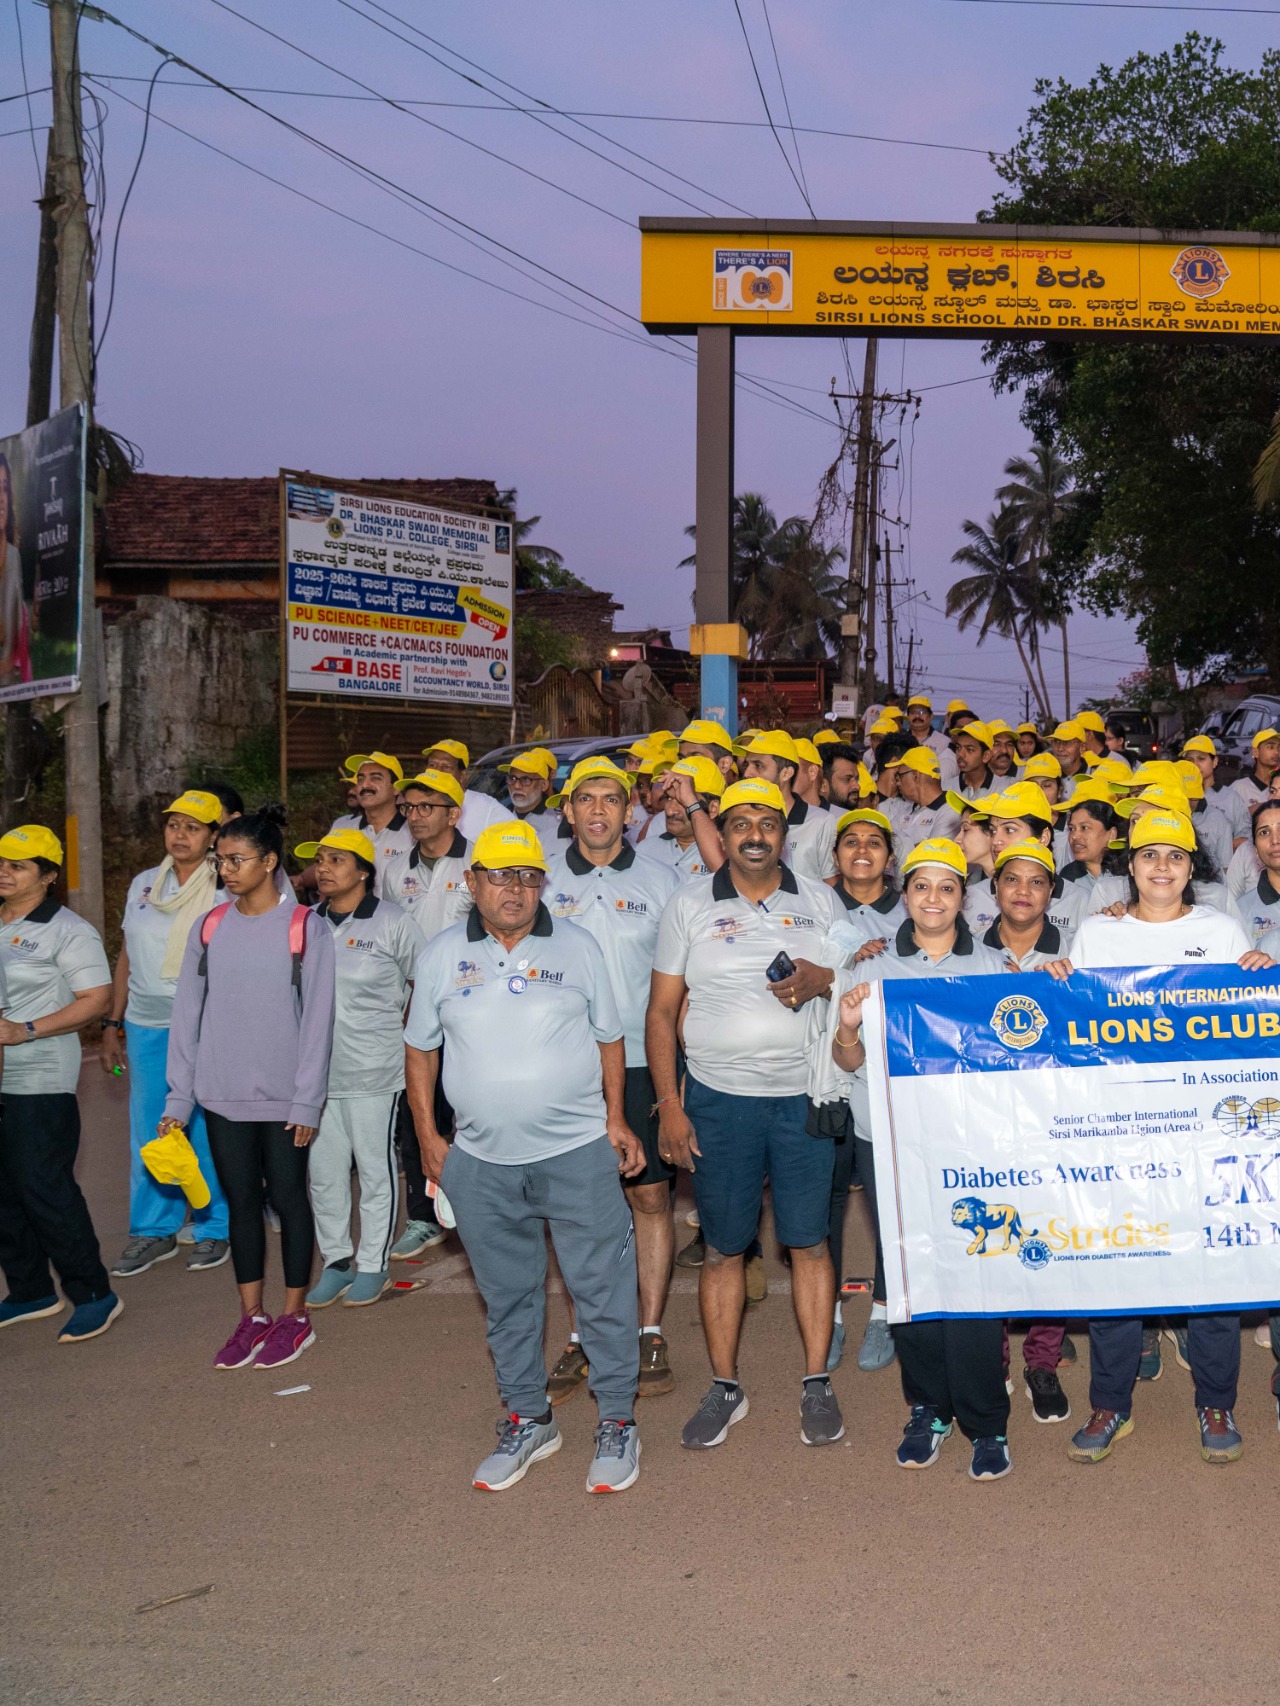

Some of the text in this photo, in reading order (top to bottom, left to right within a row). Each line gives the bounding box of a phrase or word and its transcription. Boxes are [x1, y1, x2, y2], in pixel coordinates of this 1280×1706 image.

[718, 257, 788, 266] THERE'S A LION
[938, 246, 995, 262] ನಗರಕ್ಕೆ
[1000, 247, 1073, 263] ಸುಸ್ವಾಗತ
[1184, 249, 1217, 264] LIONS
[1035, 265, 1106, 289] ಶಿರಸಿ
[816, 291, 859, 306] ಶಿರಸಿ
[933, 294, 987, 313] ಸ್ಕೂಲ್
[995, 295, 1042, 312] ಮತ್ತು
[1086, 297, 1139, 316] ಭಾಸ್ಕರ
[815, 311, 864, 323] SIRSI
[869, 312, 926, 324] LIONS
[931, 313, 1007, 326] SCHOOL
[1013, 314, 1052, 326] AND
[1057, 315, 1088, 327] DR.
[1093, 316, 1180, 330] BHASKAR
[1184, 318, 1240, 331] SWADI
[339, 496, 490, 532] SIRSI LIONS EDUCATION SOCIETY (R)
[339, 509, 491, 544] DR. BHASKAR SWADI MEMORIAL
[353, 522, 478, 553] LIONS P.U. COLLEGE, SIRSI
[323, 538, 388, 559] ಉತ್ತರಕನ್ನಡ
[295, 606, 314, 620] PU
[463, 595, 505, 620] ADMISSION
[477, 616, 501, 634] OPEN
[293, 626, 309, 641] PU
[312, 628, 378, 648] COMMERCE
[445, 642, 509, 661] FOUNDATION
[343, 647, 468, 667] in Academic partnership with
[356, 661, 402, 680] BASE
[413, 665, 472, 679] Prof. Ravi Hegde's
[338, 678, 402, 693] BANGALORE
[413, 675, 510, 693] ACCOUNTANCY WORLD, SIRSI
[413, 686, 422, 695] for
[627, 900, 648, 912] Bell
[1050, 915, 1070, 926] Bell
[20, 938, 40, 951] Bell
[356, 938, 374, 950] Bell
[1184, 949, 1203, 958] PUMA
[540, 968, 564, 982] Bell
[1002, 998, 1034, 1010] LIONS
[1107, 991, 1155, 1008] LIONS
[1012, 1011, 1028, 1030] L
[1067, 1016, 1175, 1046] LIONS
[1182, 1071, 1197, 1085] In
[1199, 1069, 1279, 1085] Association
[1211, 1094, 1247, 1119] SENIOR CHAMBER
[1052, 1107, 1198, 1126] Senior Chamber International
[1048, 1127, 1071, 1140] Sirsi
[1073, 1124, 1128, 1139] Marikamba
[1163, 1122, 1191, 1135] (Area
[941, 1166, 1043, 1190] Diabetes
[1047, 1212, 1171, 1251] Strides
[1202, 1221, 1262, 1249] 14th
[1053, 1249, 1172, 1262] LIONS FOR DIABETES AWARENESS
